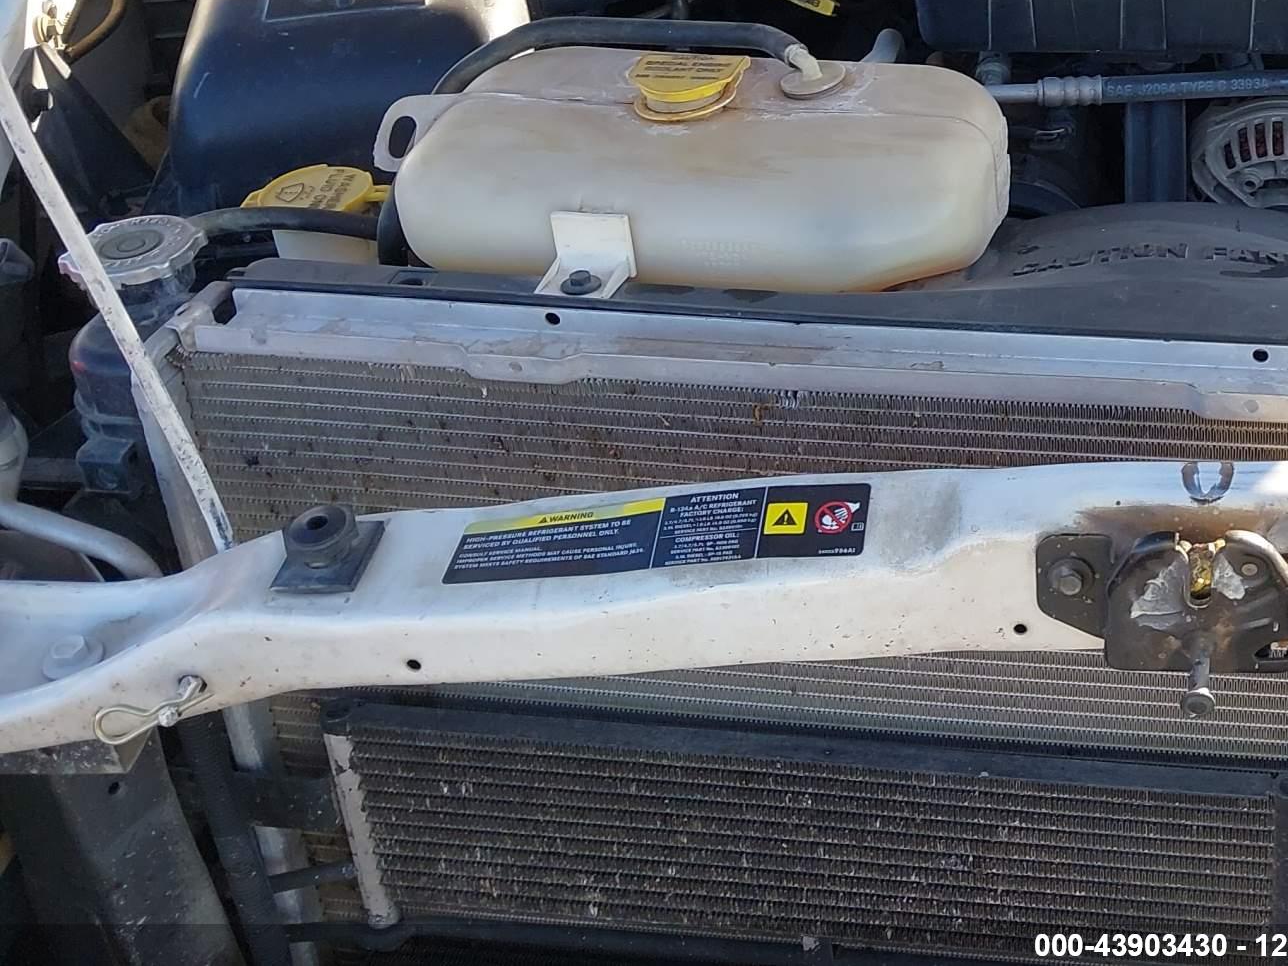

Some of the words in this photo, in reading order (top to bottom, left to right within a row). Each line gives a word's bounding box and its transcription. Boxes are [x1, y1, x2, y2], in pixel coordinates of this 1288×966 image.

[1106, 83, 1134, 96] SAE
[1180, 79, 1215, 93] TYPE
[1218, 79, 1227, 91] C
[1011, 242, 1188, 277] CAUTION
[1205, 245, 1286, 265] FAN
[690, 492, 740, 504] ATTENTION
[694, 503, 708, 511] A/C
[708, 499, 758, 509] REFRIGERANT
[549, 511, 594, 523] WARNING
[680, 509, 712, 518] FACTORY
[712, 507, 744, 515] CHARGE:
[466, 531, 527, 543] HIGH-PRESSURE
[527, 525, 580, 537] REFRIGERANT
[579, 522, 610, 532] SYSTEM
[675, 534, 724, 543] COMPRESSOR
[463, 541, 501, 550] SERVICED
[512, 535, 552, 545] QUALIFIED
[552, 531, 598, 541] PERSONNEL
